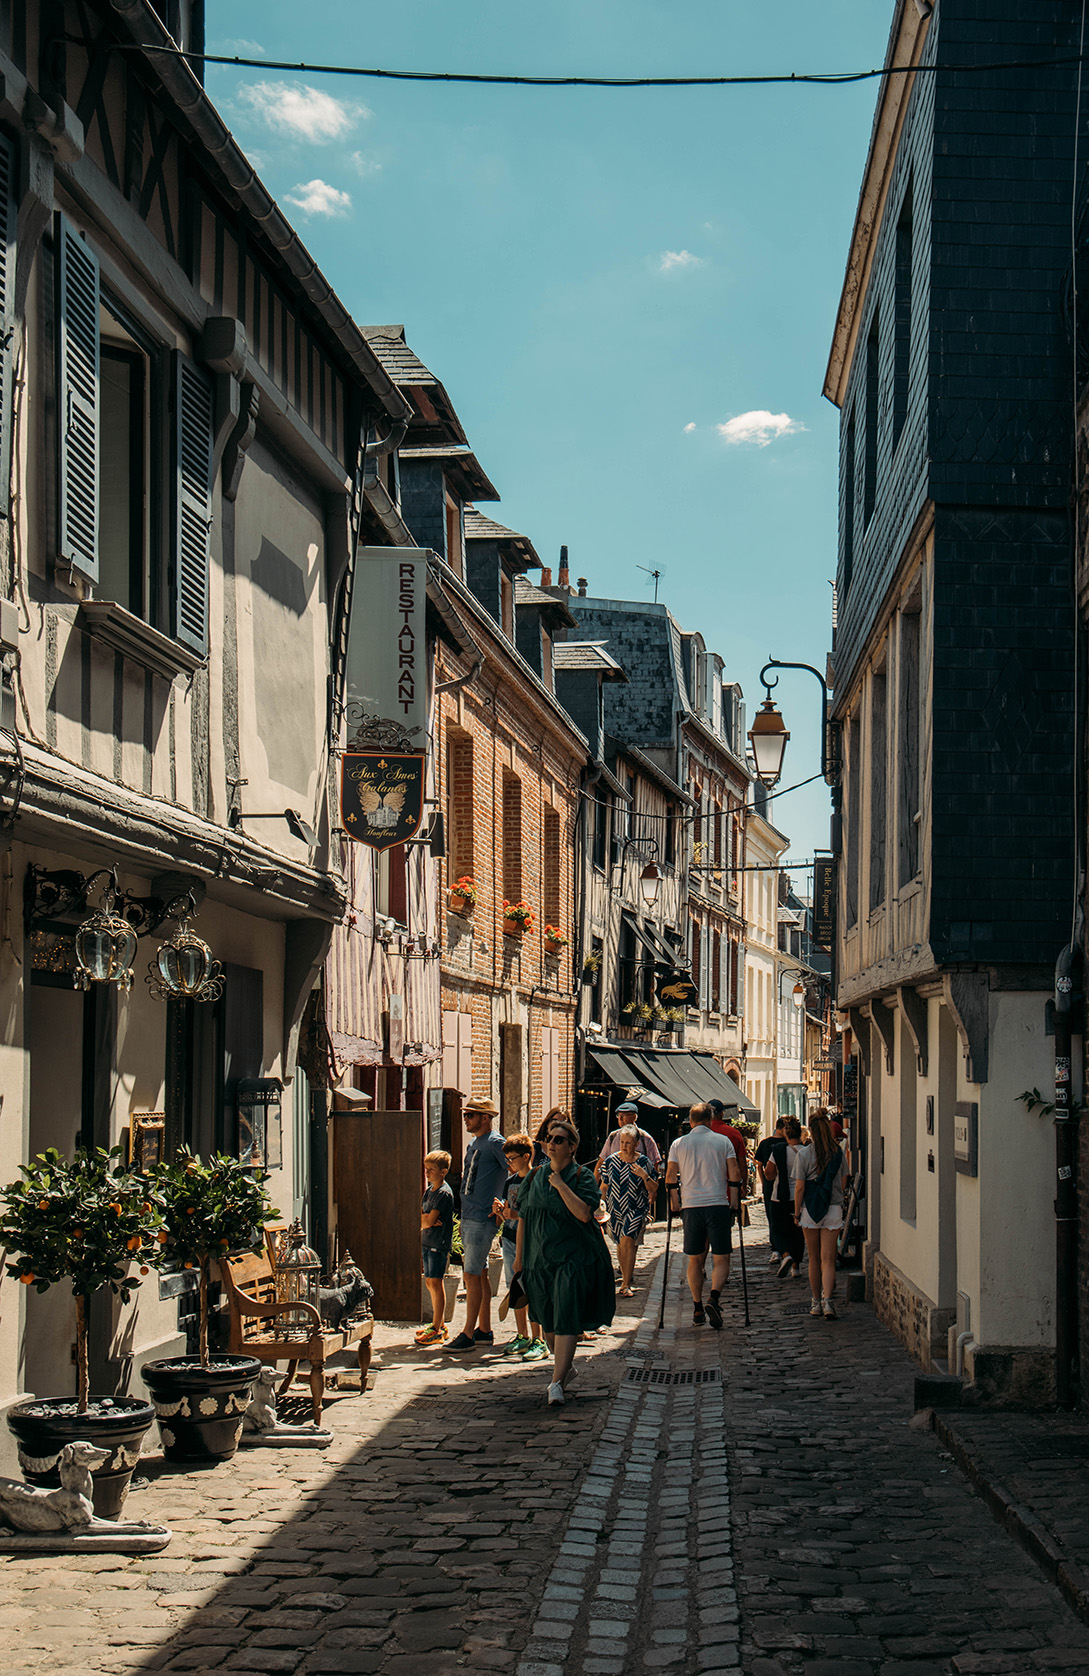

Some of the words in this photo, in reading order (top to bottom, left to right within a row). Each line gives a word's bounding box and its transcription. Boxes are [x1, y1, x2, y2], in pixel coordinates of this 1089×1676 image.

[398, 563, 415, 714] RESTAURANT
[347, 763, 379, 781] Aux
[382, 764, 418, 782] Ames
[356, 780, 408, 795] Galantes
[363, 826, 397, 839] Honfleur
[824, 867, 832, 887] Belle
[822, 889, 832, 918] Epoque
